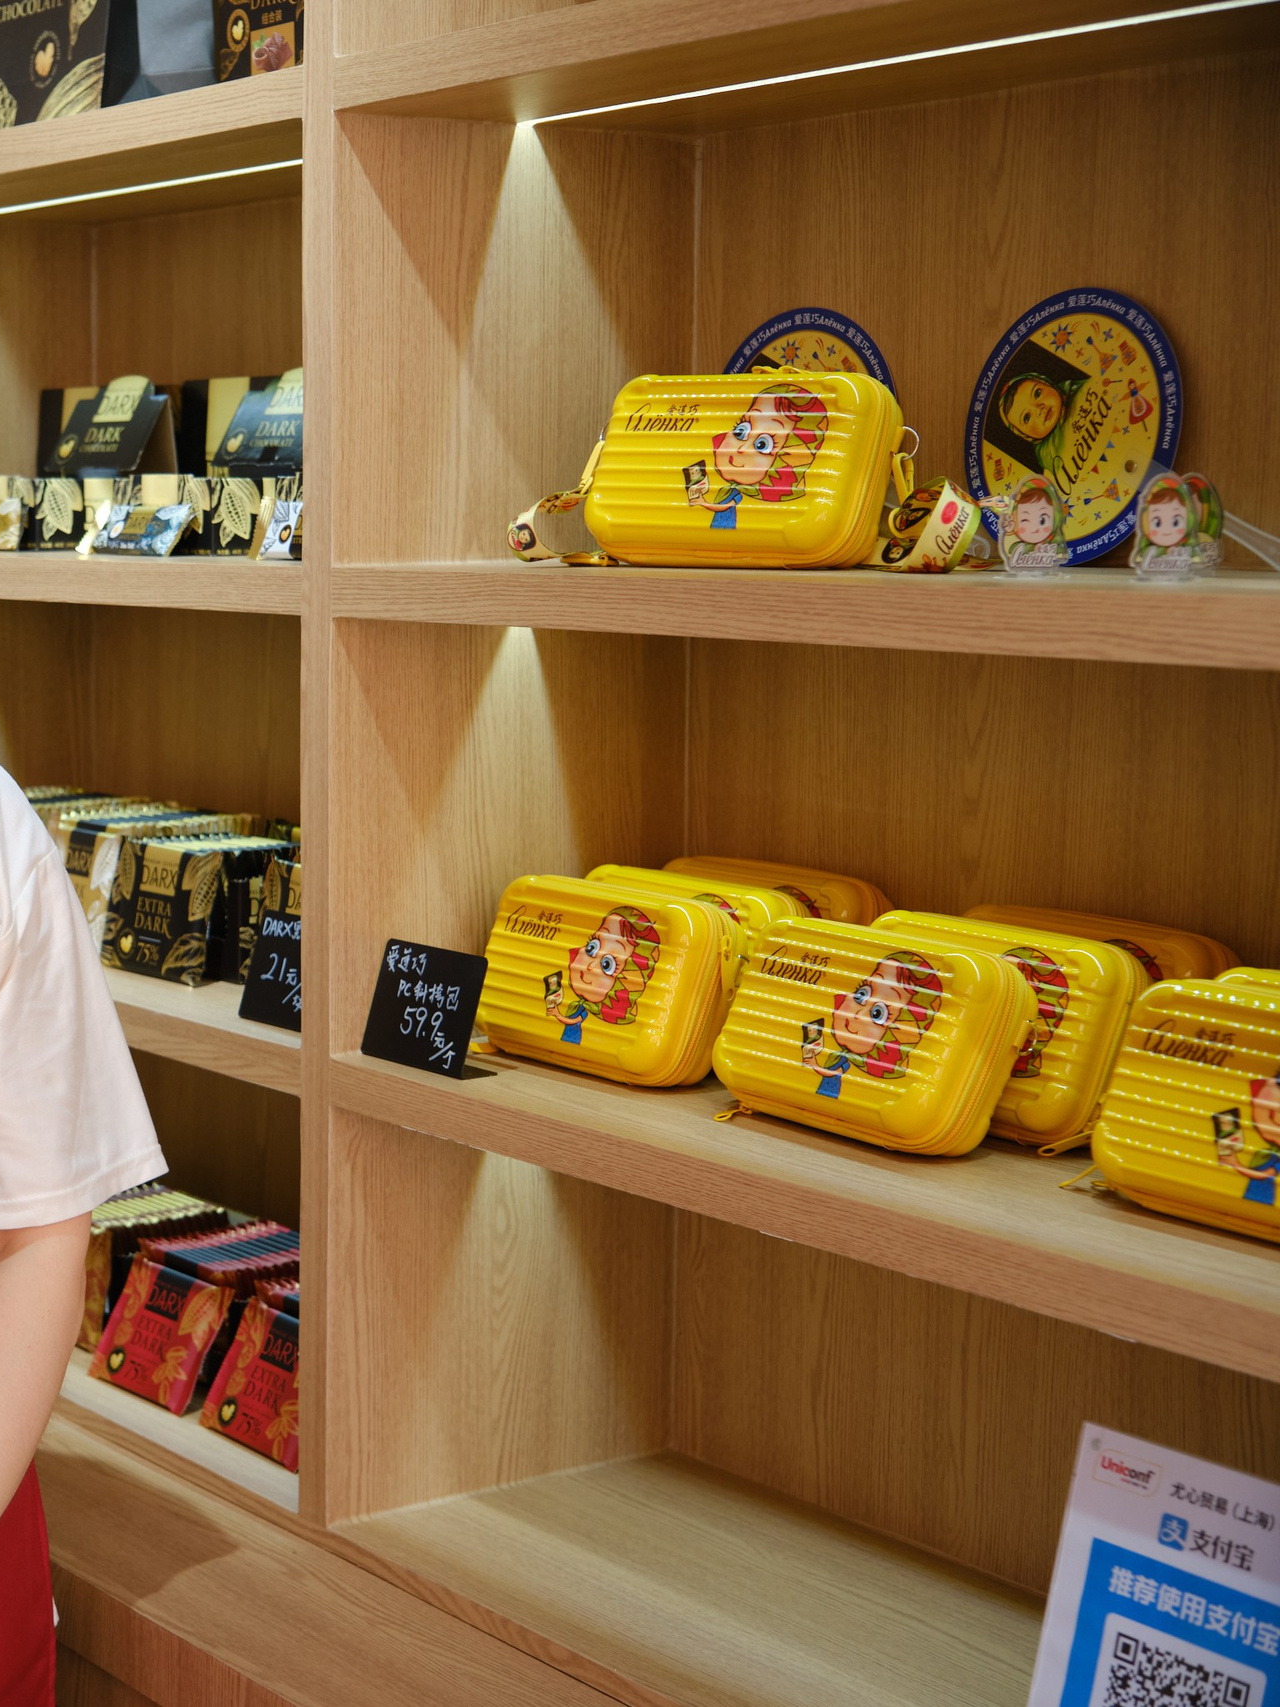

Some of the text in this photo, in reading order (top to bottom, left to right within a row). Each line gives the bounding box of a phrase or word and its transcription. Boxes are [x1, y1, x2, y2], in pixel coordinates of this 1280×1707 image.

[84, 426, 126, 443] DARK
[255, 420, 300, 437] DARK
[936, 506, 970, 555] Алёнка
[142, 864, 179, 889] DARX
[137, 896, 171, 917] EXTRA
[134, 912, 172, 940] DARK
[136, 942, 159, 962] 75%
[146, 1285, 186, 1315] DARX
[137, 1314, 172, 1341] EXTRA
[131, 1329, 167, 1361] DARK
[251, 1364, 287, 1392] EXTRA
[243, 1381, 281, 1417] DARK
[236, 1411, 262, 1436] 75%
[1101, 1456, 1156, 1484] Uniconf
[1191, 1529, 1255, 1572] 支付宝
[1108, 1565, 1280, 1657] 推荐使用支付宝
